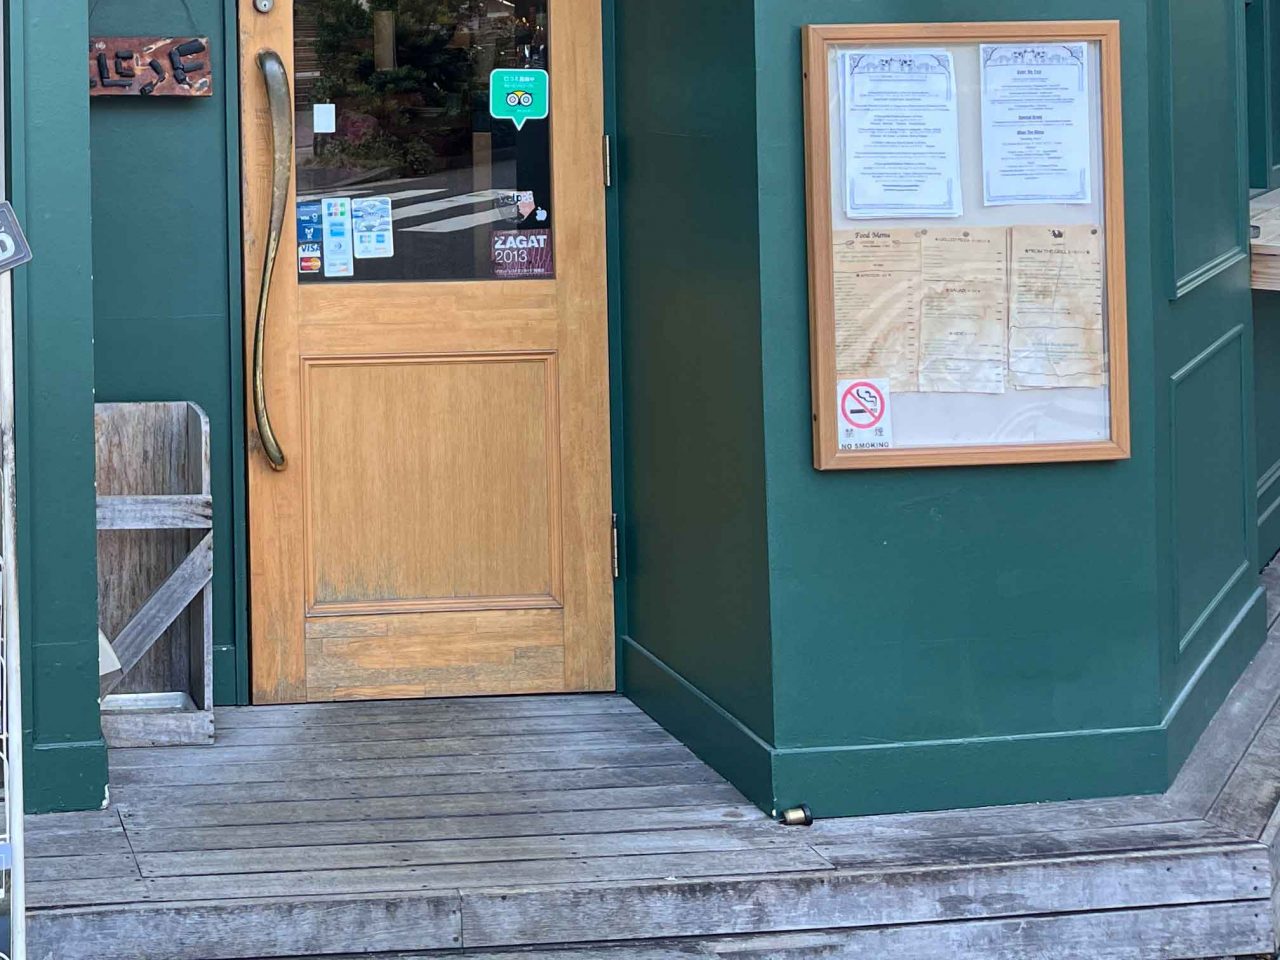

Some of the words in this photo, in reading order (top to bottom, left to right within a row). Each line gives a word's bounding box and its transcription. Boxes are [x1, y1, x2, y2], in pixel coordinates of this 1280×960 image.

[301, 242, 320, 253] VISA
[494, 234, 547, 249] ZAGAT
[494, 249, 528, 263] 2013
